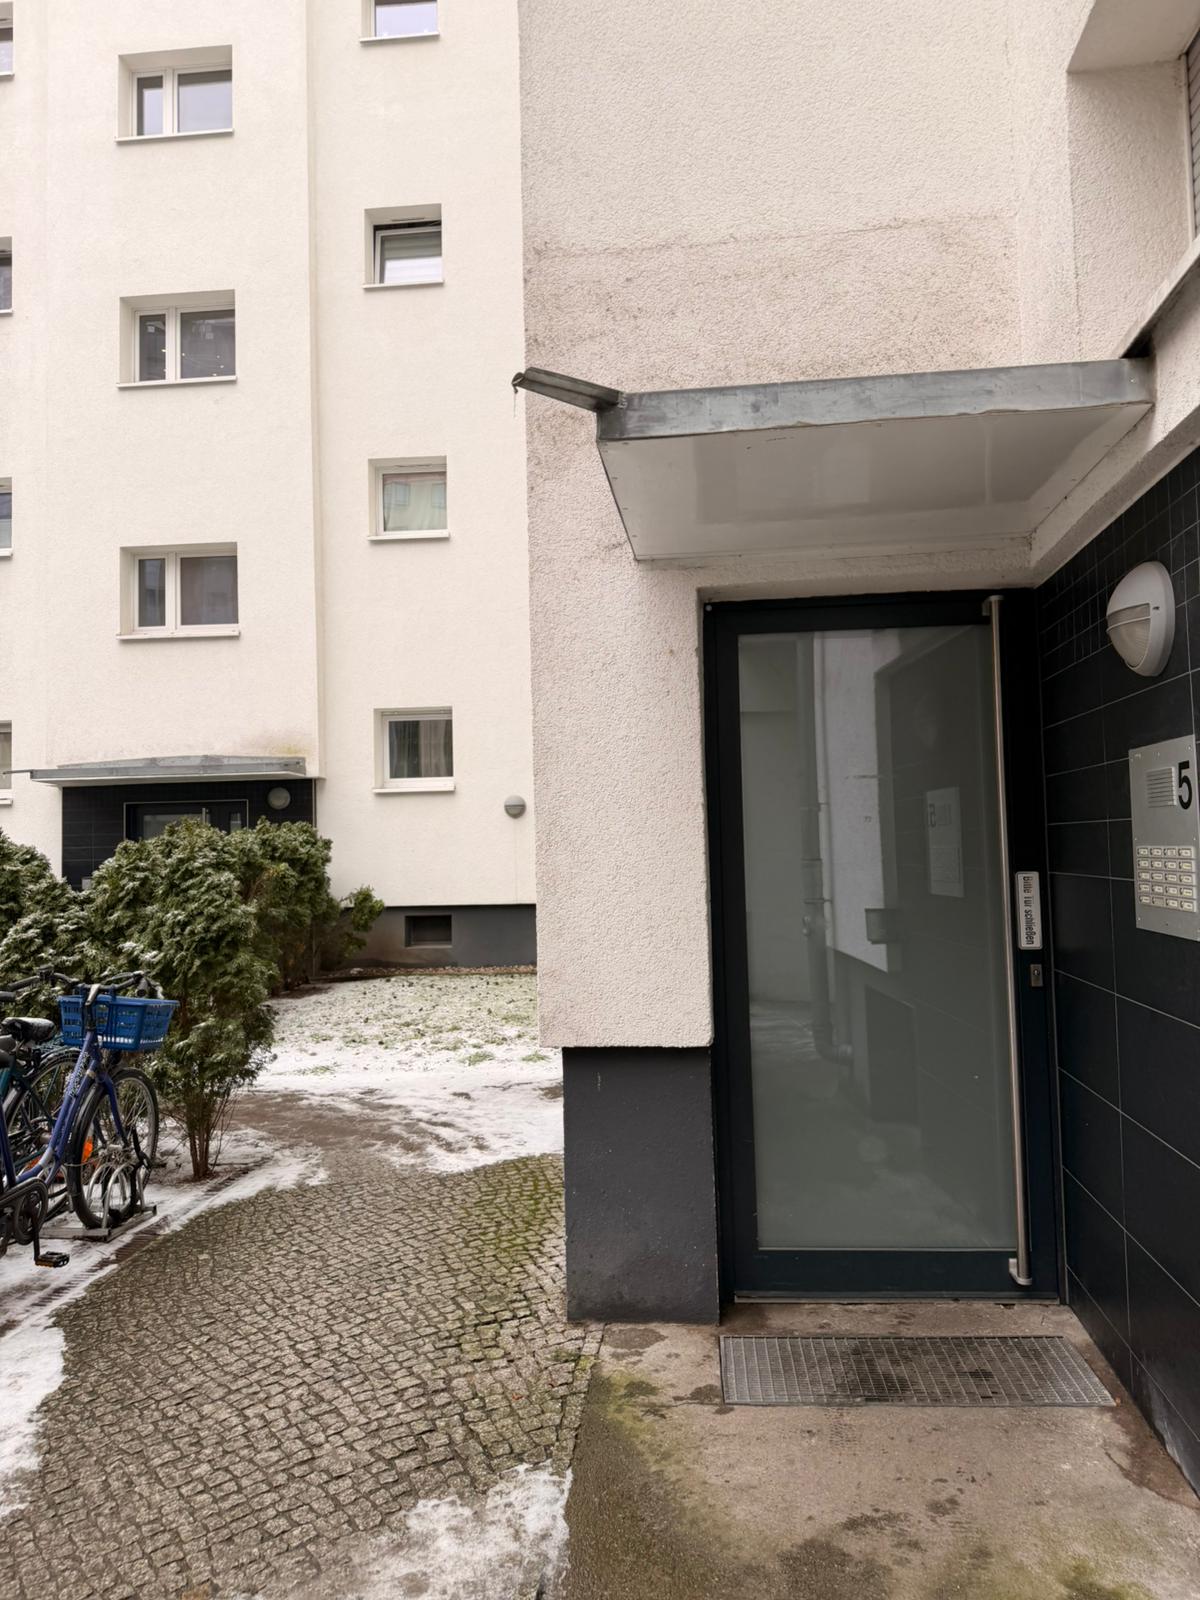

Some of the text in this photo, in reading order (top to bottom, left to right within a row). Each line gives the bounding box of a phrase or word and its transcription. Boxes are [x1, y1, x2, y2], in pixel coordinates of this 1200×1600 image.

[1178, 760, 1192, 810] 5
[1023, 876, 1036, 945] Bitte Tür schließen
